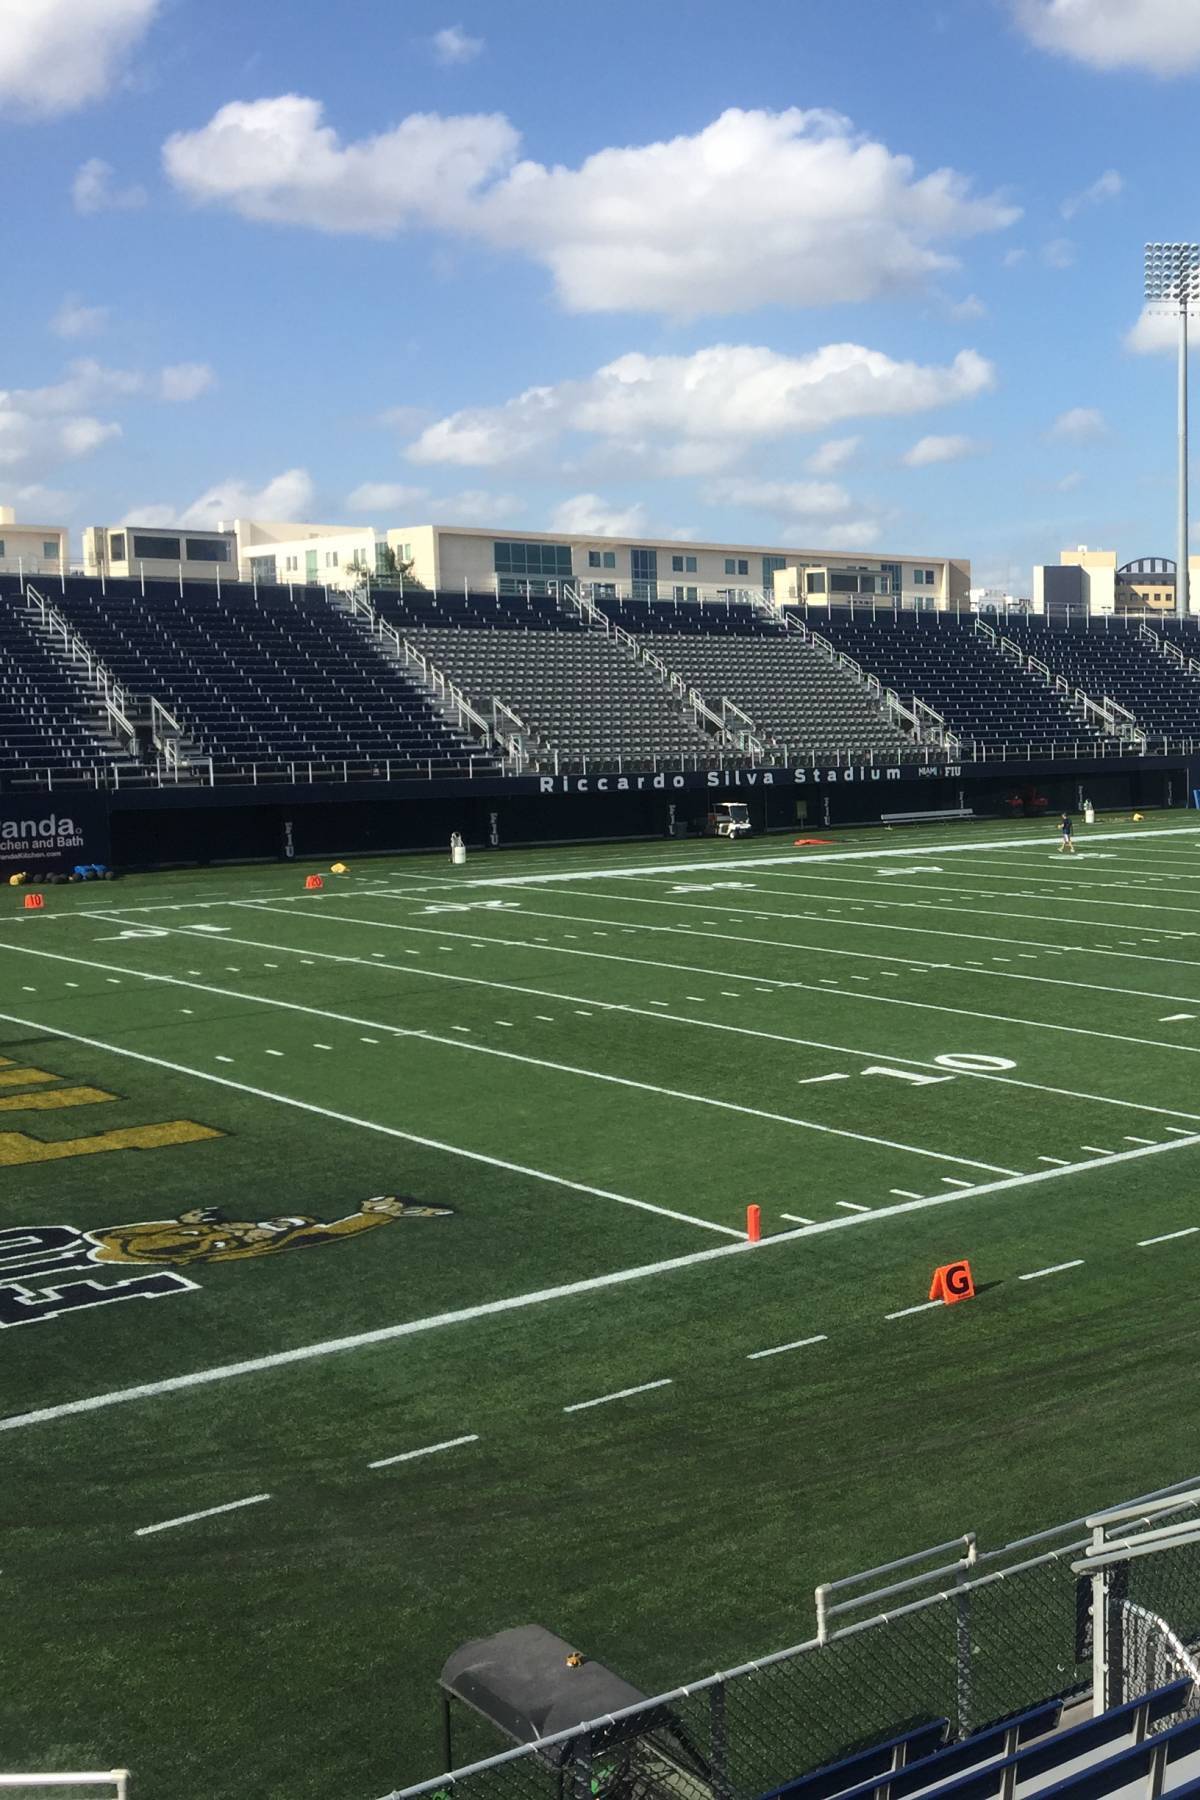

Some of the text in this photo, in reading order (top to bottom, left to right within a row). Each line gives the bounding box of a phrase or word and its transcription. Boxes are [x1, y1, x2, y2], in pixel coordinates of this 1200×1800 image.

[540, 773, 685, 792] Riccardo
[707, 770, 774, 787] Silva
[794, 766, 900, 783] Stadium
[945, 766, 961, 777] FIU
[0, 813, 74, 838] anda
[0, 836, 84, 851] chen and Bath
[30, 895, 41, 906] 10
[859, 1053, 1017, 1086] 10
[945, 1265, 970, 1295] G
